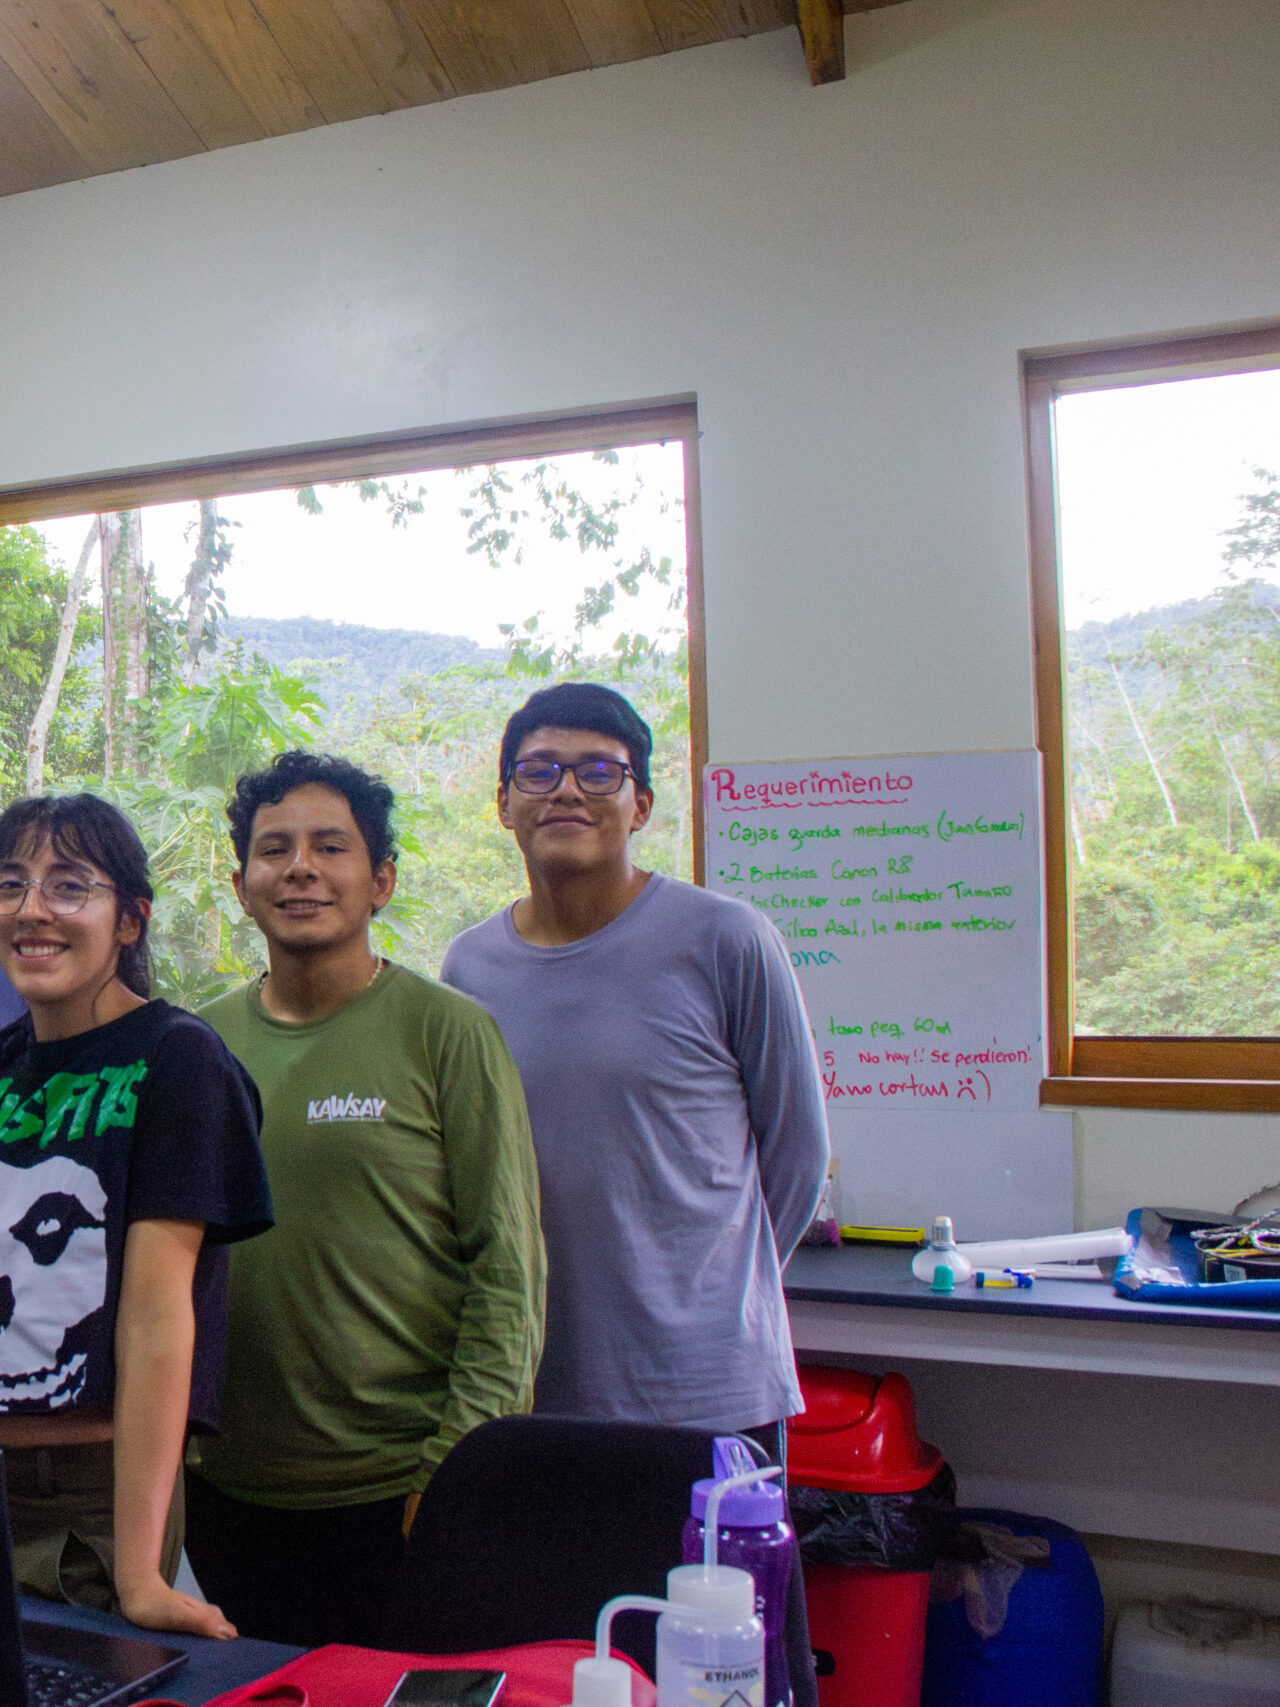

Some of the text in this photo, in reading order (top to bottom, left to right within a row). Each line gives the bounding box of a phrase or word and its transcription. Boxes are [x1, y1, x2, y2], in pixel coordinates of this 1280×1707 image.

[711, 769, 913, 806] Requerimiento
[729, 821, 779, 847] Cajas
[788, 824, 841, 851] guarda
[852, 821, 930, 838] medianas
[724, 863, 741, 883] 2
[830, 859, 878, 880] Canon
[888, 855, 914, 874] R8
[859, 1052, 880, 1064] No
[931, 1049, 951, 1063] Se
[307, 1092, 386, 1121] KAWSAY
